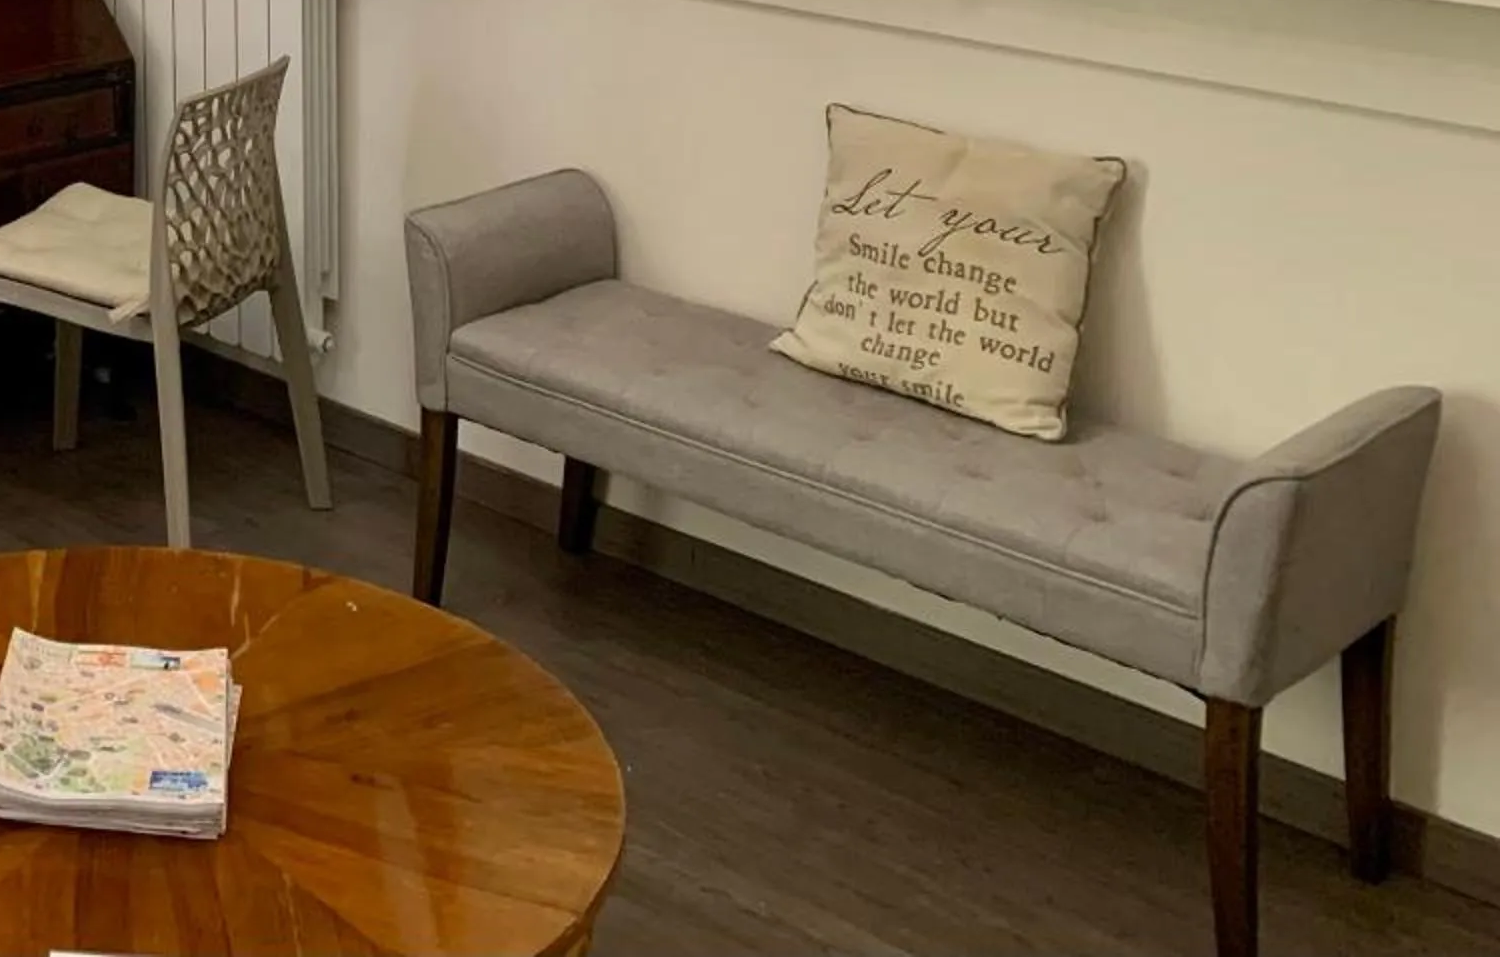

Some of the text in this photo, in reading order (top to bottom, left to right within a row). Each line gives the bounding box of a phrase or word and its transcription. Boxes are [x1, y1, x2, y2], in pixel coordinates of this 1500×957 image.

[831, 167, 1068, 258] Let your
[848, 232, 1018, 294] Smile change
[847, 272, 1021, 333] the world but
[860, 334, 942, 370] change
[886, 310, 916, 336] let
[928, 318, 967, 346] the
[979, 334, 1056, 374] world
[901, 380, 966, 409] smile
